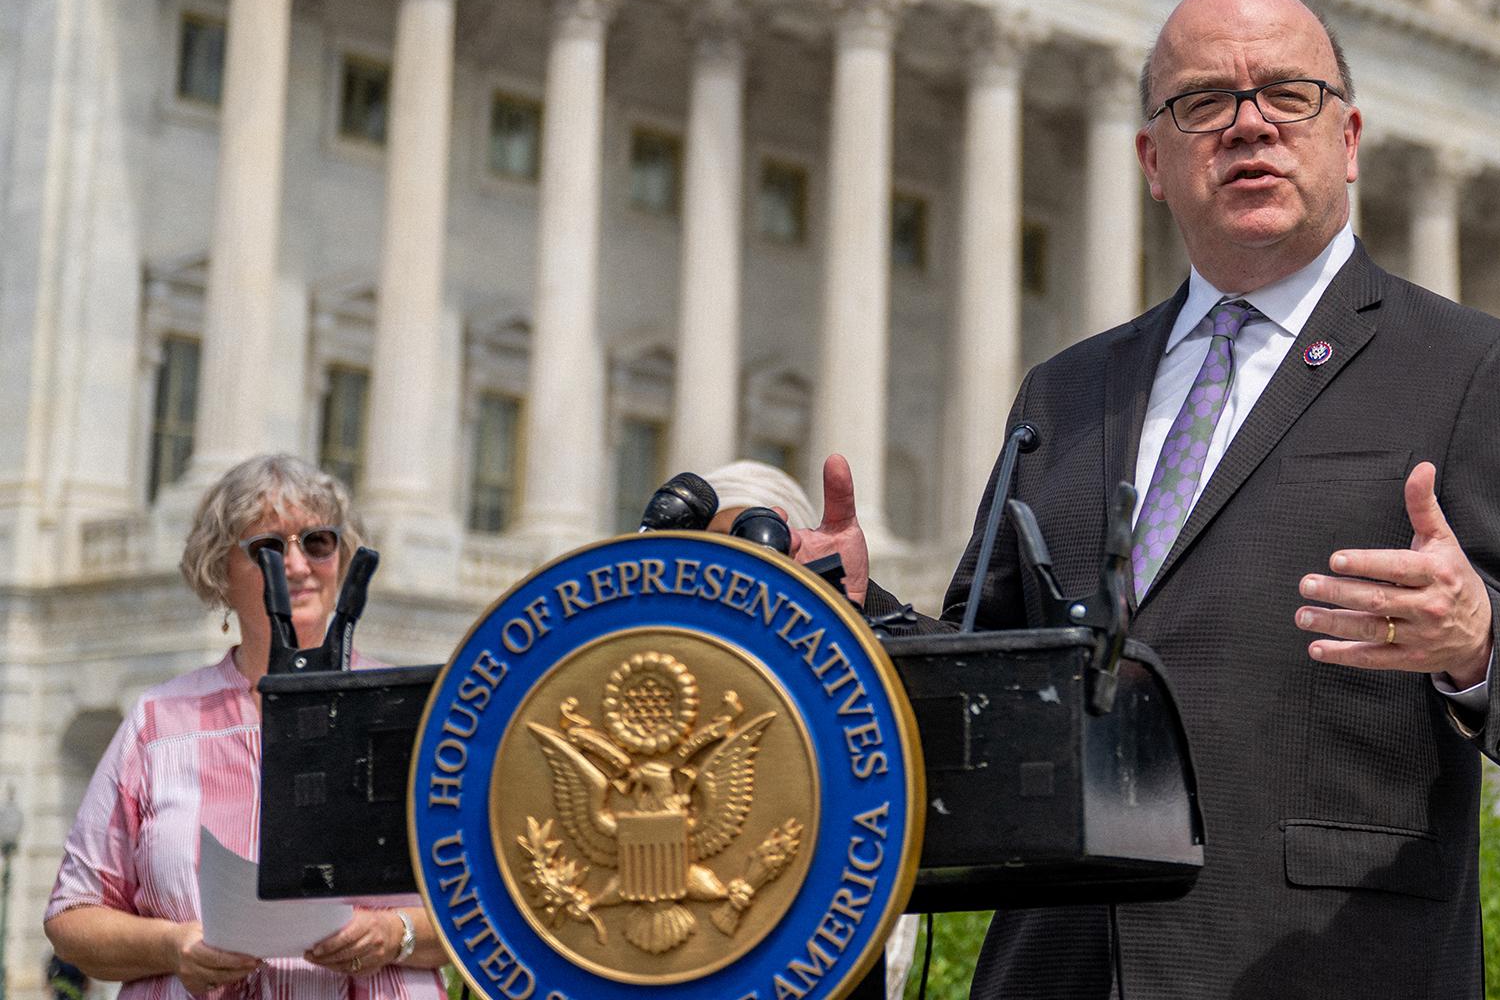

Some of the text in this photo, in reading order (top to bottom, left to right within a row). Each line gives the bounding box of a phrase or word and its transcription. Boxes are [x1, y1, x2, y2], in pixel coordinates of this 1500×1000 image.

[428, 558, 889, 809] HOUSE OF REPRESENTATIVES
[431, 801, 890, 1000] UNITED AMERICA
